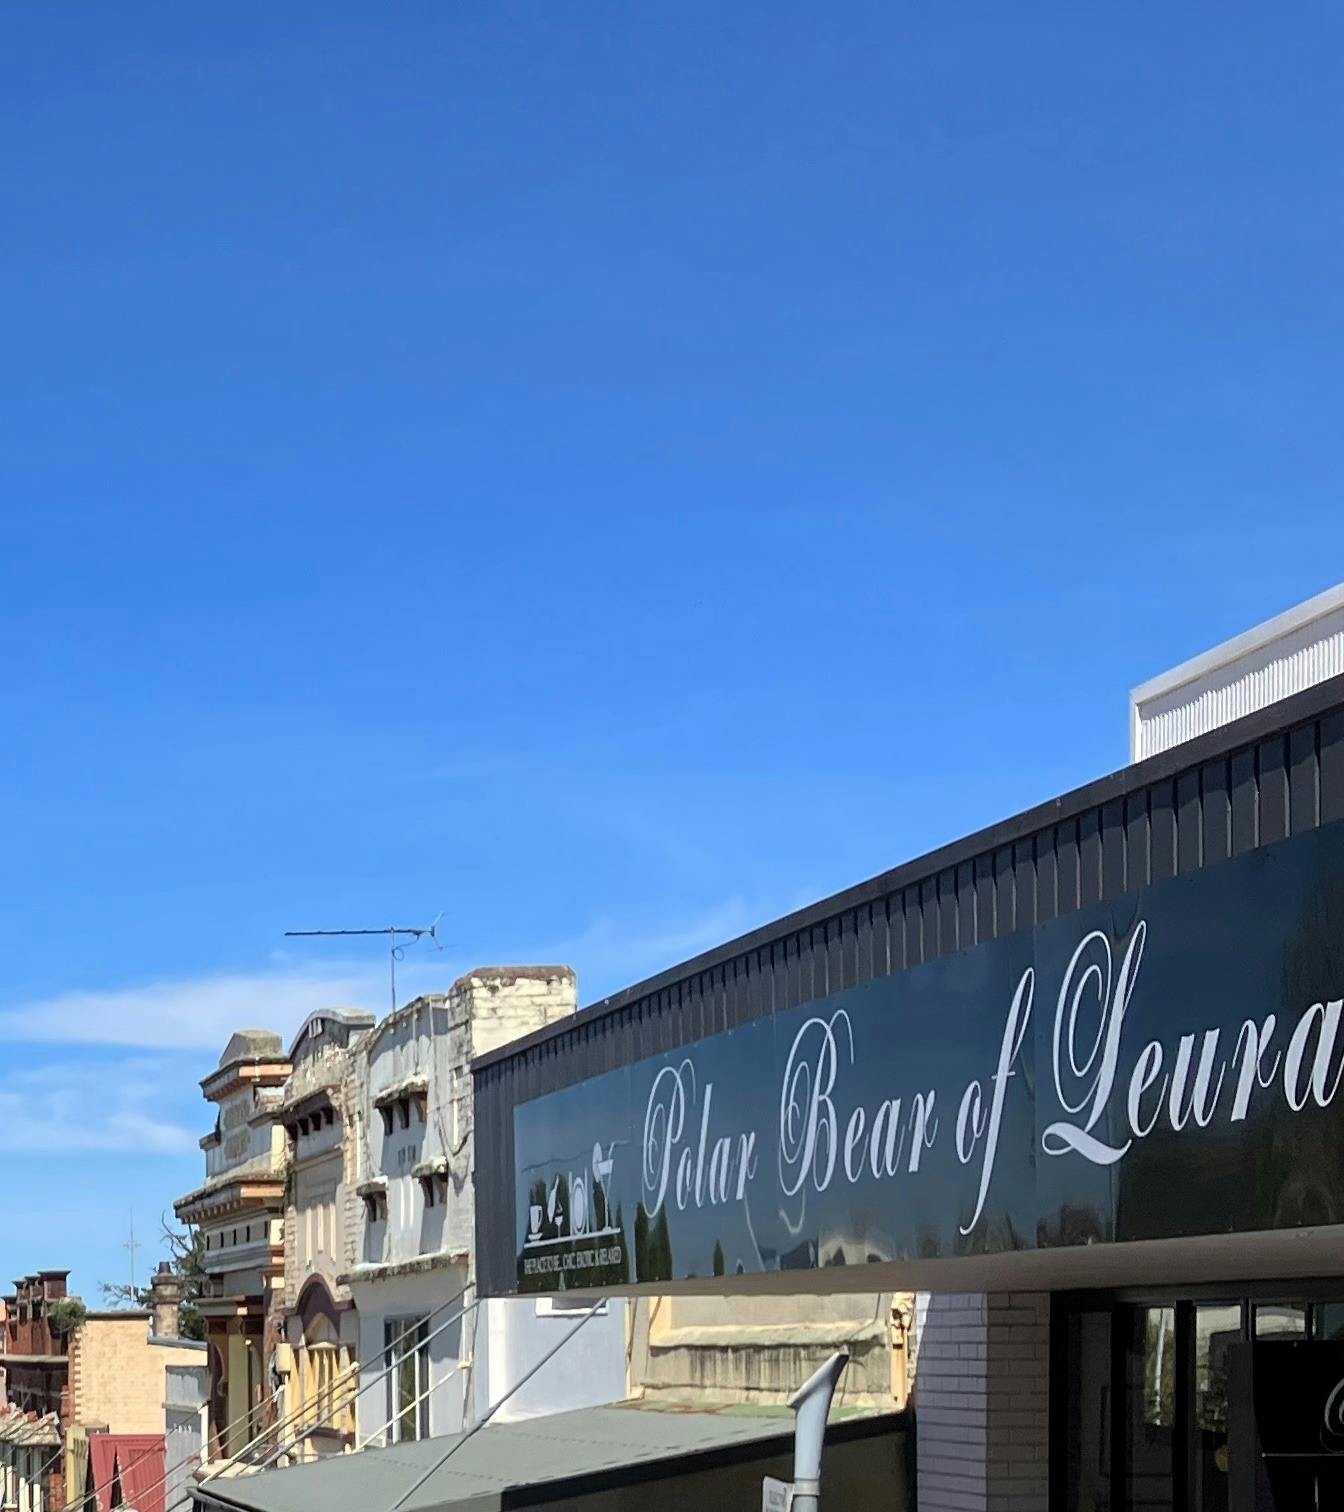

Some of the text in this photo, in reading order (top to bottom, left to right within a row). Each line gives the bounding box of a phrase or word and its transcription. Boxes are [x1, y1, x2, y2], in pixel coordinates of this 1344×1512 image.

[642, 919, 1344, 1236] Polar Bear of Leura
